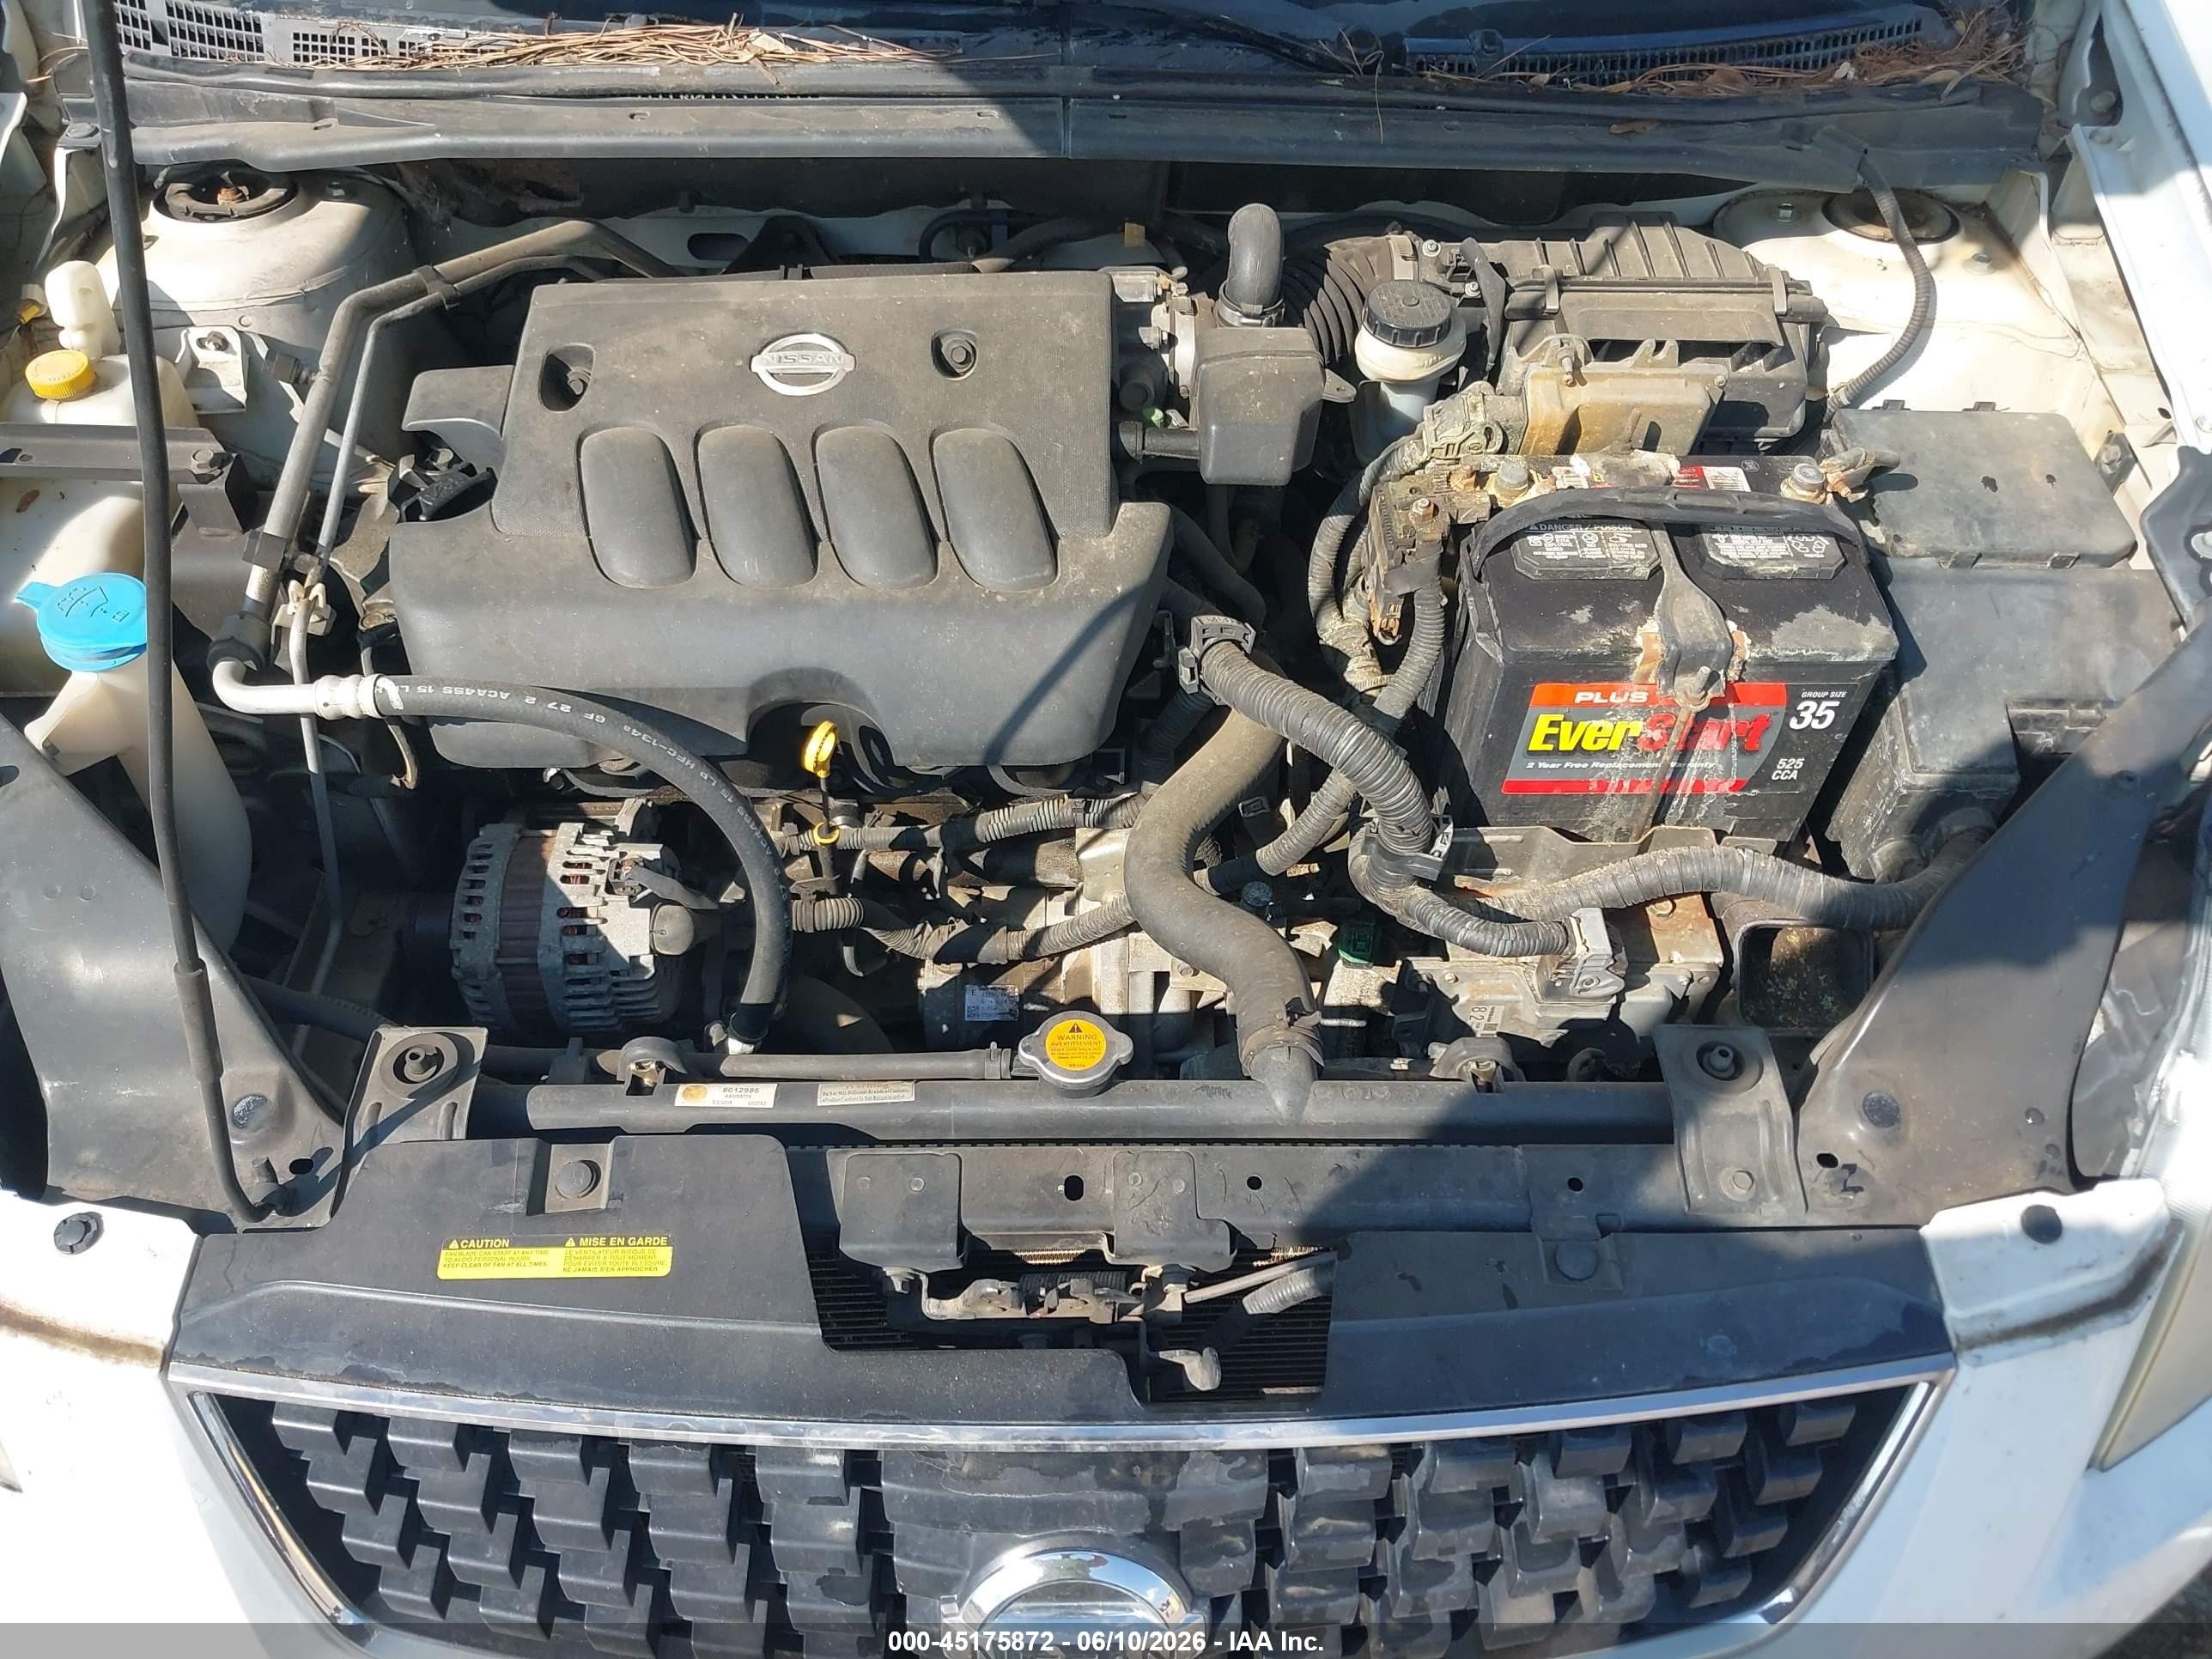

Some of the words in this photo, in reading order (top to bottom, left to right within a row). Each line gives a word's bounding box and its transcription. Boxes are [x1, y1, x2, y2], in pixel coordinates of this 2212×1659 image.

[763, 353, 844, 365] NISSAN
[416, 685, 434, 694] 15
[525, 696, 537, 705] 2
[1574, 691, 1650, 704] PLUS
[547, 701, 572, 714] 27
[583, 713, 606, 724] GF
[1789, 701, 1840, 730] 35
[1776, 758, 1805, 769] 525
[1771, 769, 1798, 781] CCA
[459, 1238, 511, 1249] CAUTION
[579, 1237, 607, 1246] MISE
[609, 1237, 625, 1246] EN
[628, 1237, 668, 1246] GARDE
